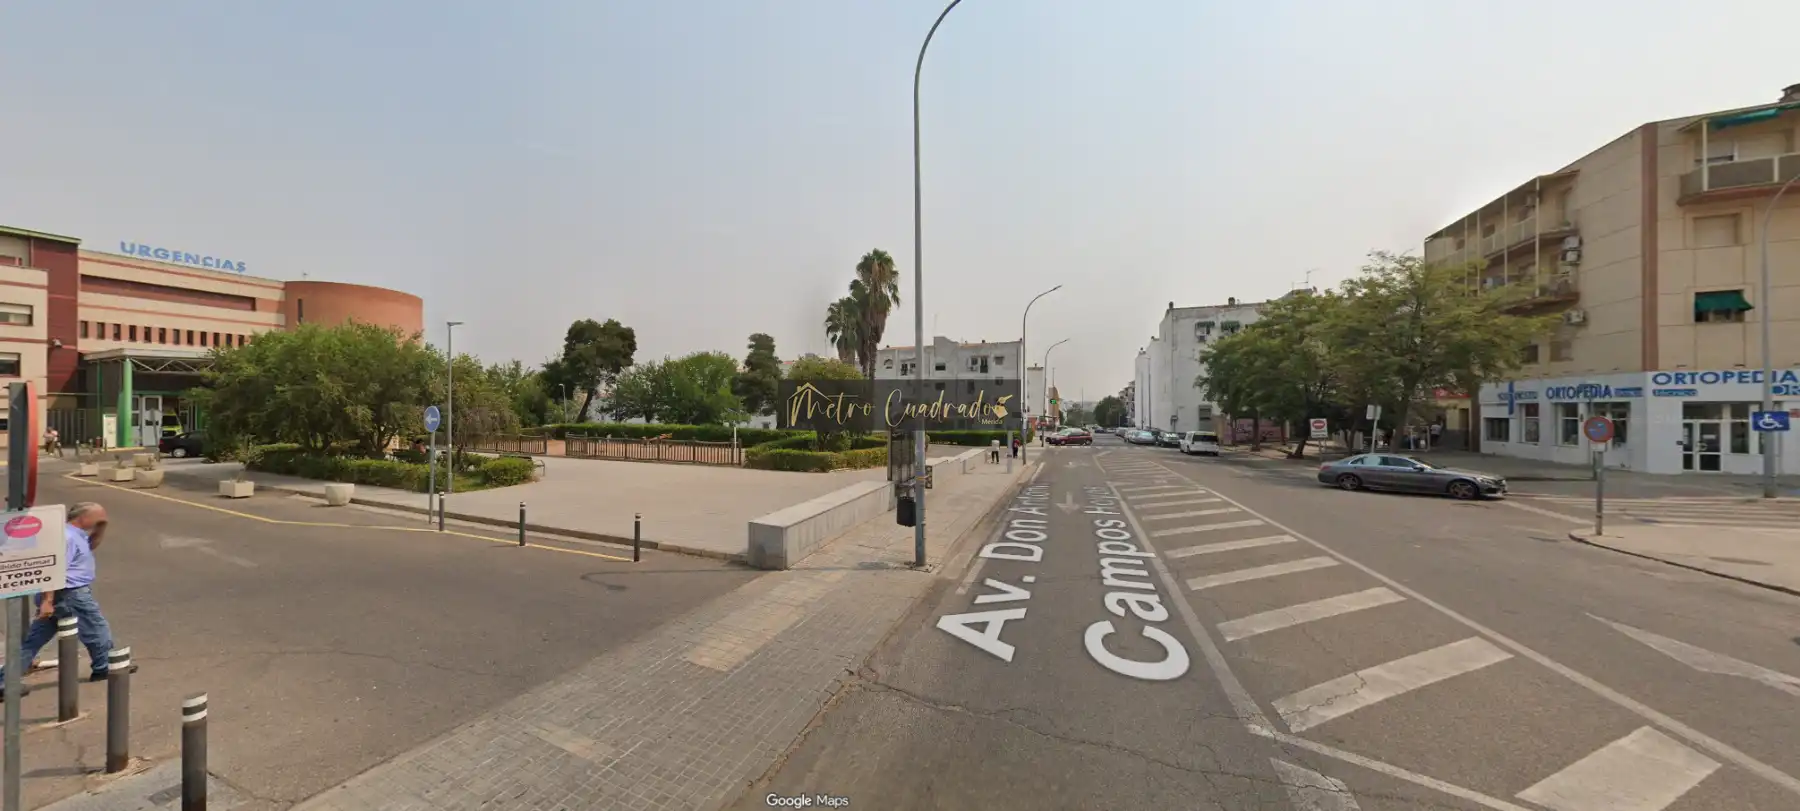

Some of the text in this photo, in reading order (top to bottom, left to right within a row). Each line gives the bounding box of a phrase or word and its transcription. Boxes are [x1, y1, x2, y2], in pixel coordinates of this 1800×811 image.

[120, 241, 247, 272] URGENCIAS
[1652, 370, 1798, 385] ORTOPEDIA
[1546, 384, 1612, 400] ORTOPEDIA
[24, 558, 51, 568] fumar
[6, 569, 43, 580] TODO
